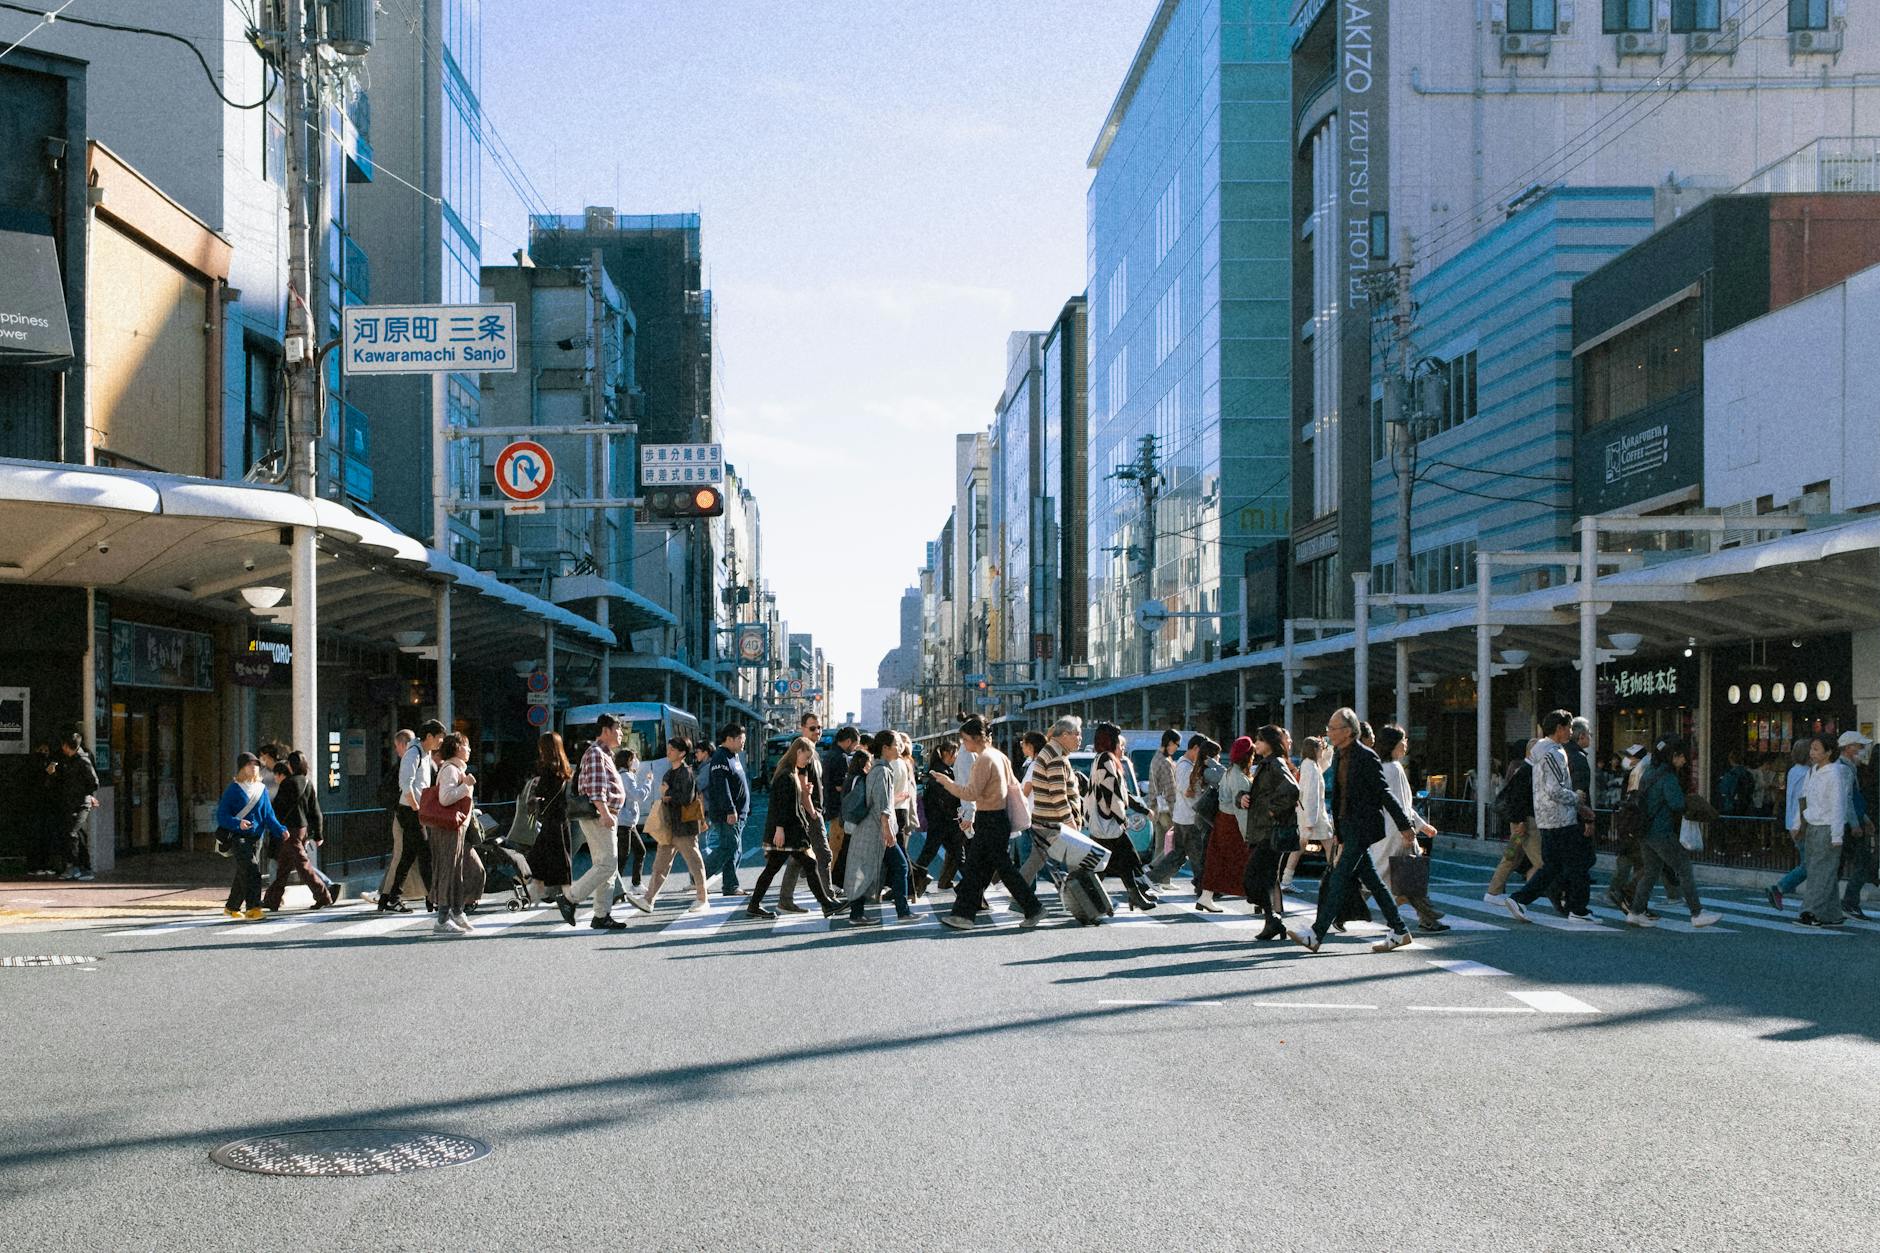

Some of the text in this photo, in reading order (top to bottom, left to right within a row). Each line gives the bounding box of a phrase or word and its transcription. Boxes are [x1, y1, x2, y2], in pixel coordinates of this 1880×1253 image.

[1345, 0, 1372, 310] AKIZO IZUTSU HOTEL
[353, 315, 506, 344] 河原町 三条
[353, 346, 506, 363] Kawaramachi Sanjo
[645, 447, 718, 462] 歩車分離信号
[645, 467, 719, 481] 時差式信号機
[1241, 502, 1289, 529] mi
[745, 638, 760, 651] 40
[1599, 667, 1677, 698] 屋珈琲本店
